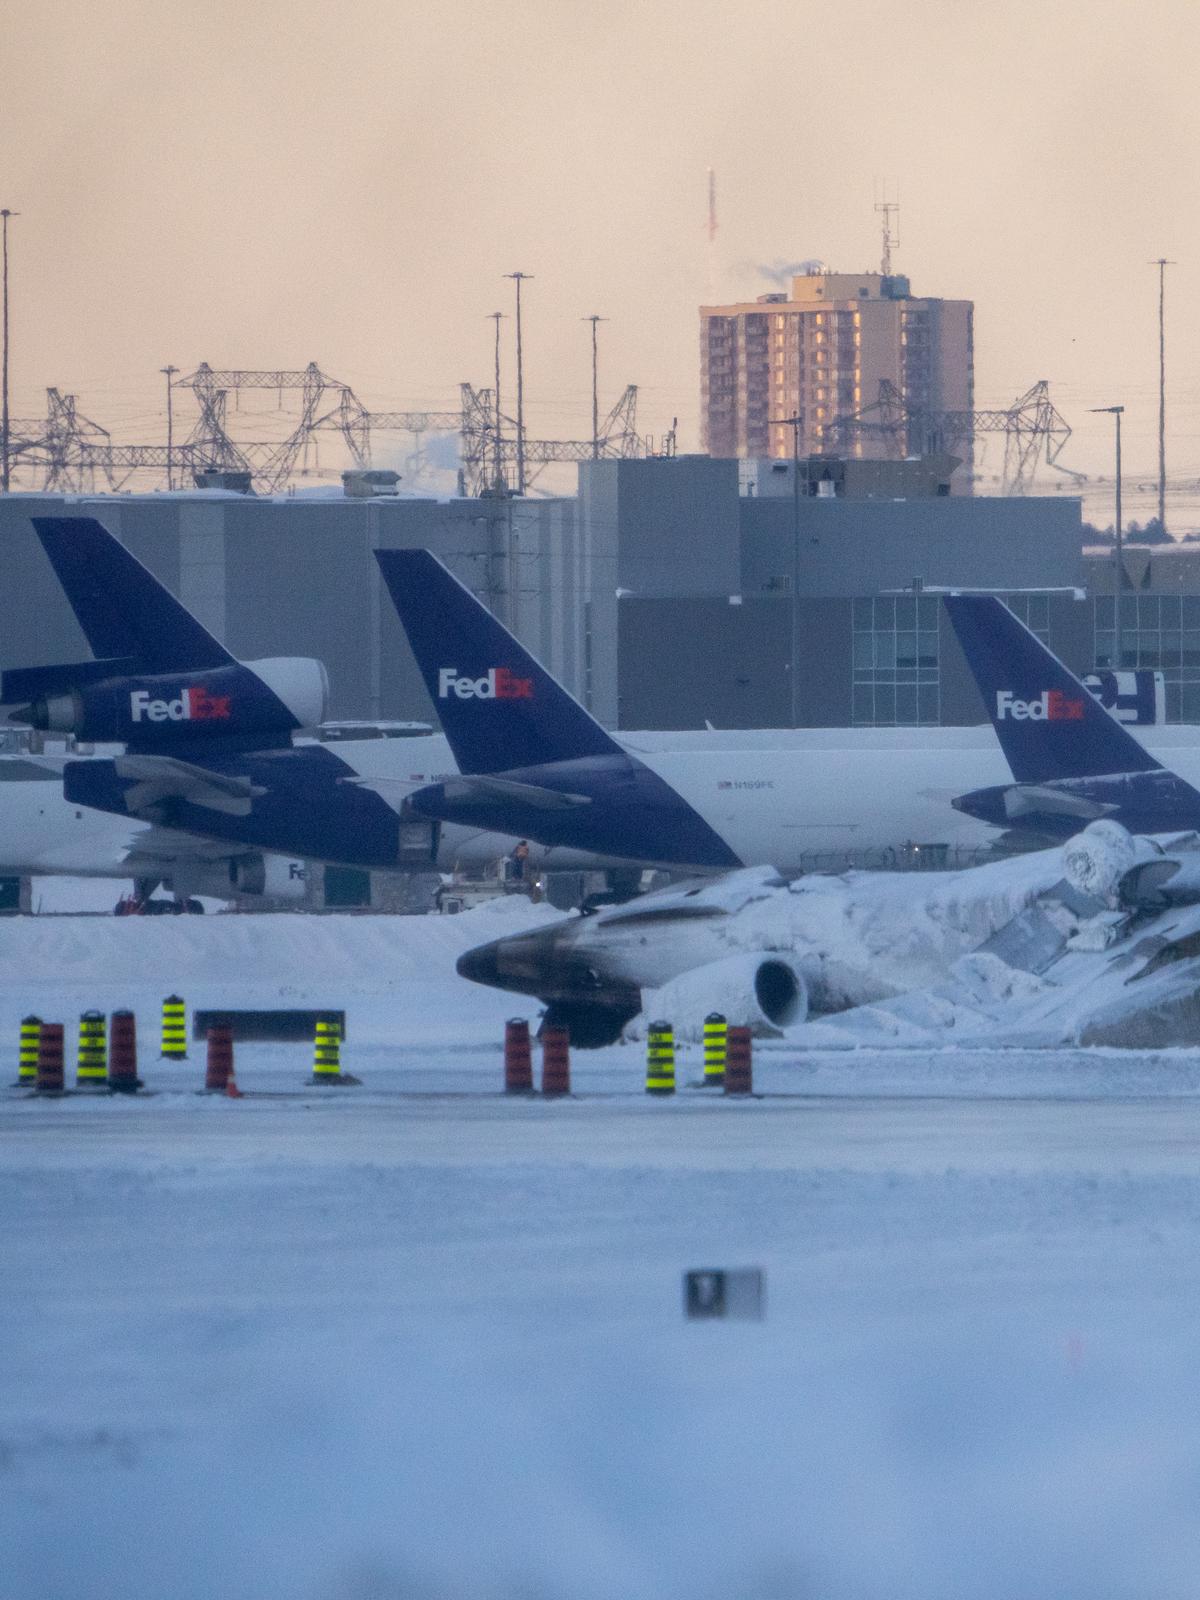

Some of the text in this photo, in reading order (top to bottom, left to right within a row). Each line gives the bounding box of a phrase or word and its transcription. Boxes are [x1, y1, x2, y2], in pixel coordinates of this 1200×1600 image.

[439, 667, 532, 699] FedEx
[130, 687, 230, 722] FedEx
[997, 690, 1083, 720] FedEx
